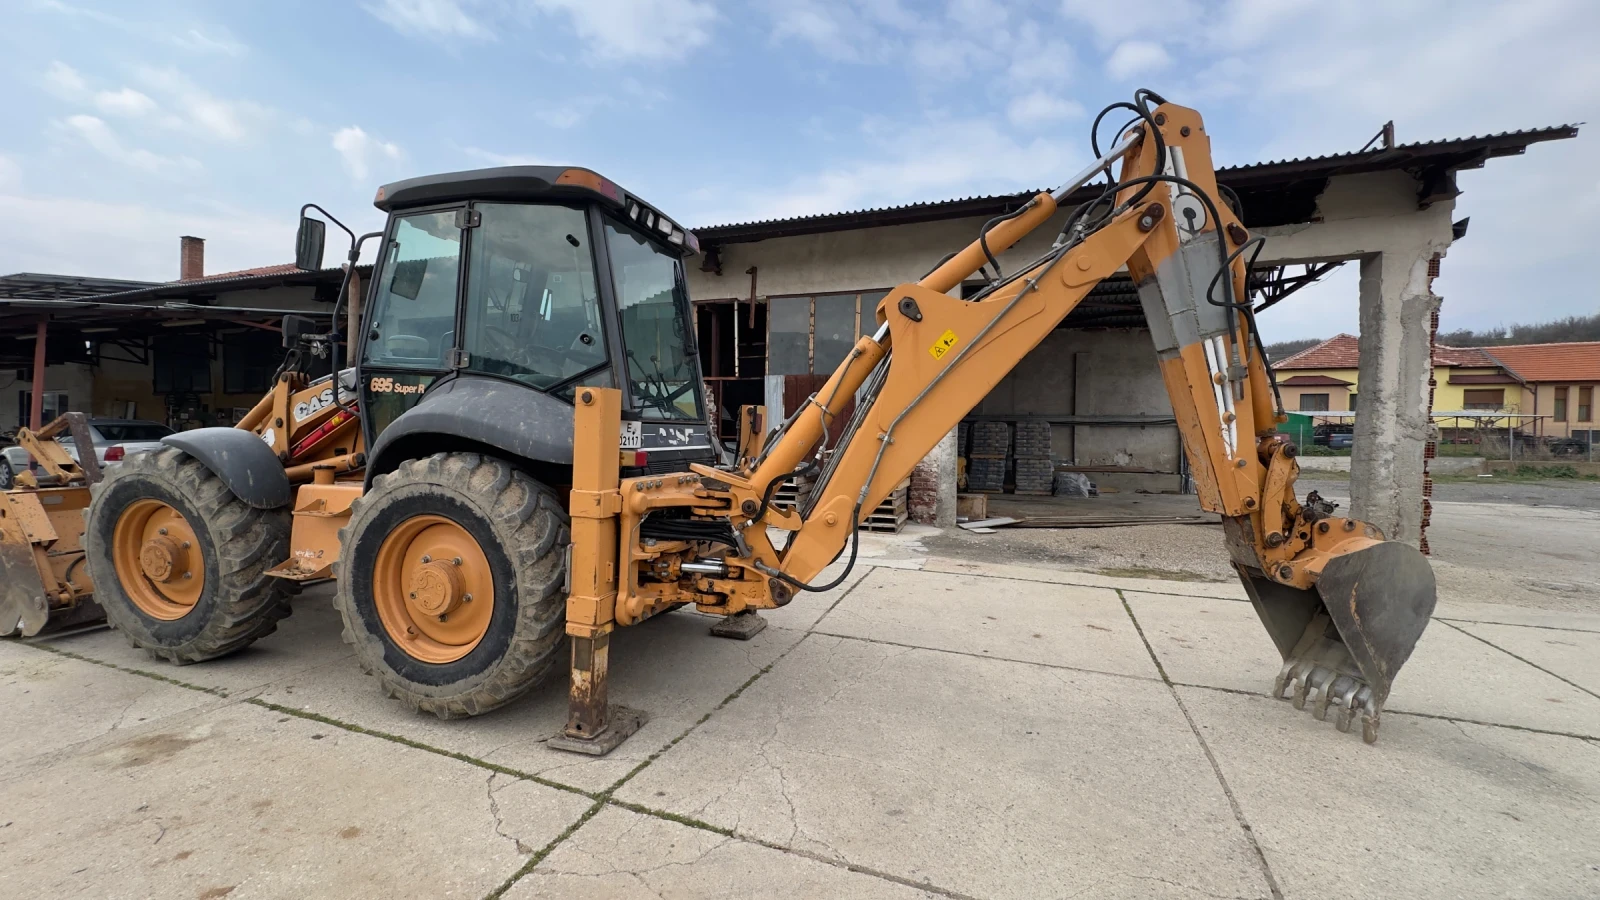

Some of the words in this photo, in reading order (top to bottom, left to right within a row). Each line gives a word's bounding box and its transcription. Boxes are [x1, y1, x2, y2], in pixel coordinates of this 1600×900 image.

[371, 378, 393, 392] 695
[394, 383, 418, 396] Super
[418, 384, 425, 394] R
